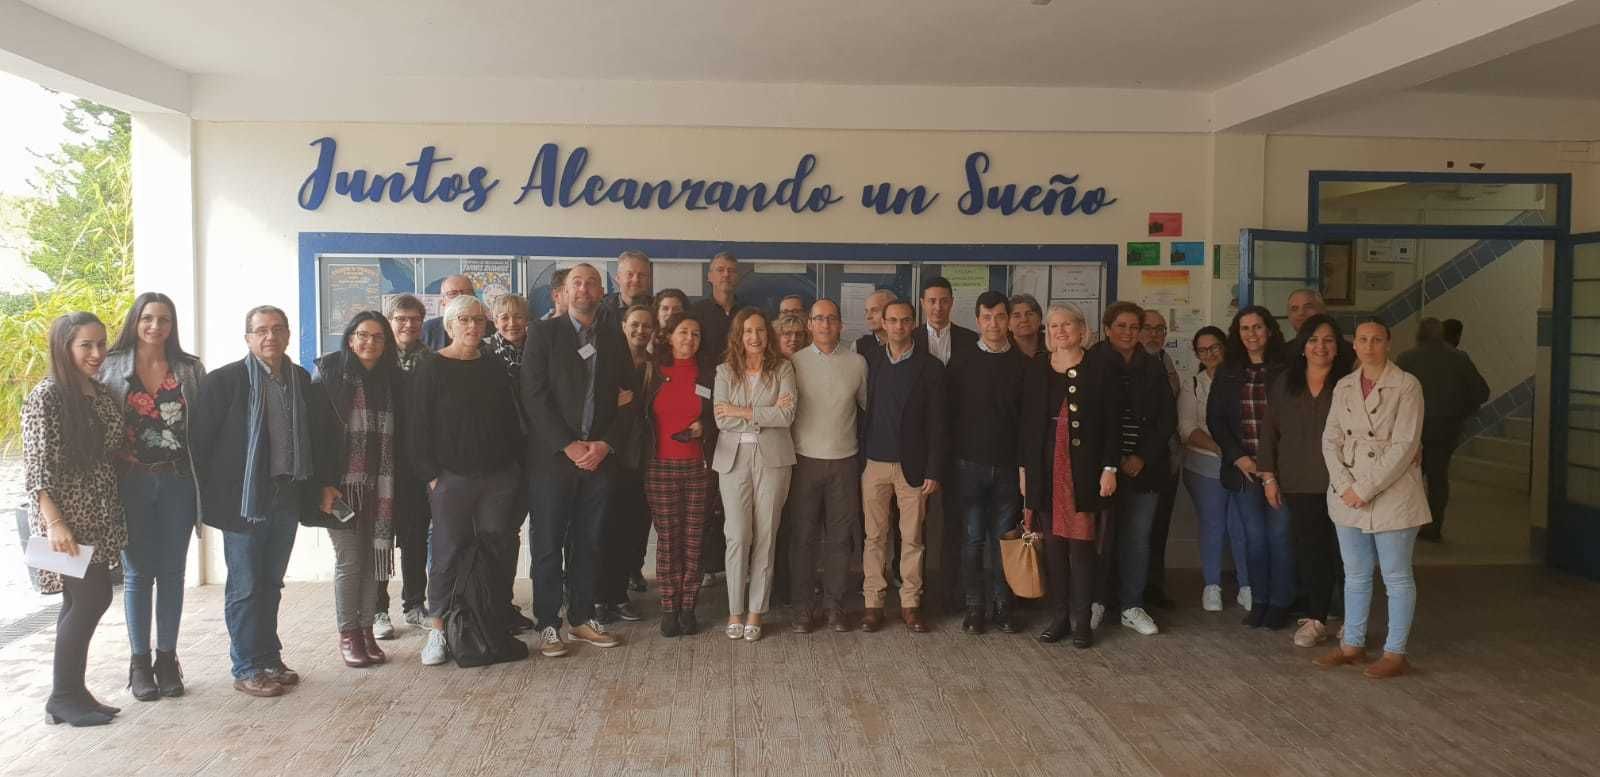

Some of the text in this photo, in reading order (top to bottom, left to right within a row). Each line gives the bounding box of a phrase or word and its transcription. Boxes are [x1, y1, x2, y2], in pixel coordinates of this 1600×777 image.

[297, 137, 1117, 216] Juntos Alcanzando un Sueño
